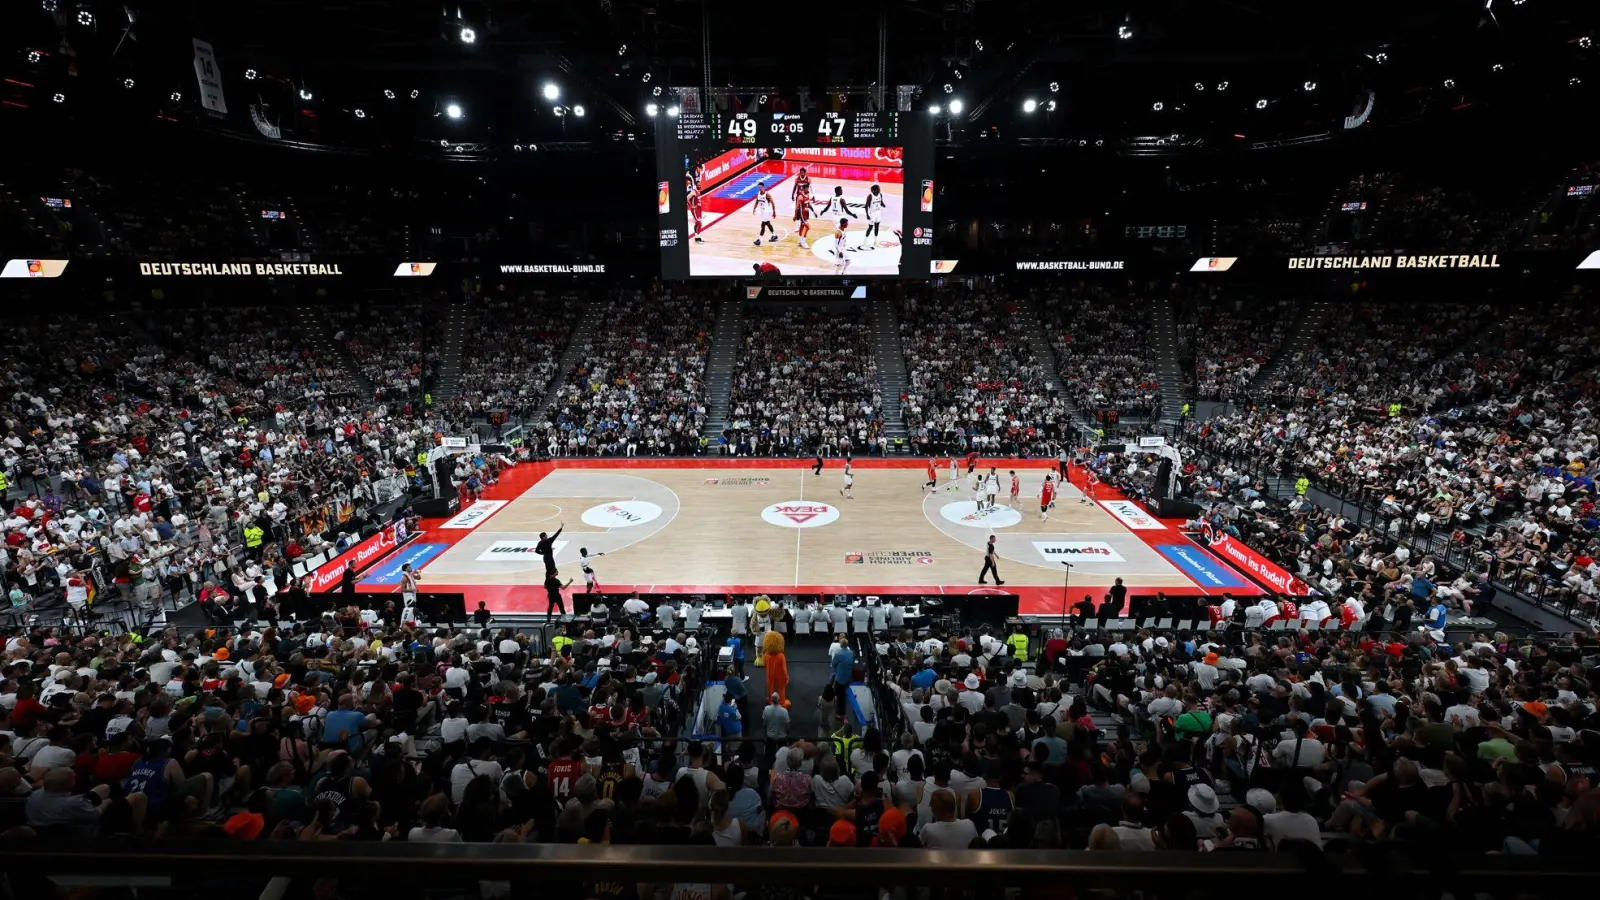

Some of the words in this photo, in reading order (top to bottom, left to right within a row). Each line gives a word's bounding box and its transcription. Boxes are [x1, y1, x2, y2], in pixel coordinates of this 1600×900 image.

[728, 119, 757, 137] 49
[771, 123, 804, 133] 02:05
[818, 118, 846, 136] 47
[823, 148, 837, 157] ins
[1016, 261, 1124, 270] WWW.BASKETBALL-BUND.DE
[1288, 256, 1392, 269] DEUTSCHLAND
[1396, 254, 1501, 268] BASKETBALL
[140, 262, 252, 276] DEUTSCHLAND
[256, 263, 342, 276] BASKETBALL
[501, 265, 606, 273] WWW.BASKETBALL-BUND.DE
[1110, 502, 1138, 516] ING
[454, 511, 484, 526] ING
[616, 511, 642, 522] ING
[358, 541, 380, 560] Rudel!
[1044, 547, 1110, 556] tipwin
[1225, 541, 1247, 564] Komm
[1248, 558, 1259, 570] ins
[1260, 564, 1286, 589] Rudel!
[318, 566, 345, 586] Komm
[132, 768, 156, 778] WAGNER
[552, 776, 570, 798] 14
[603, 780, 614, 800] 0
